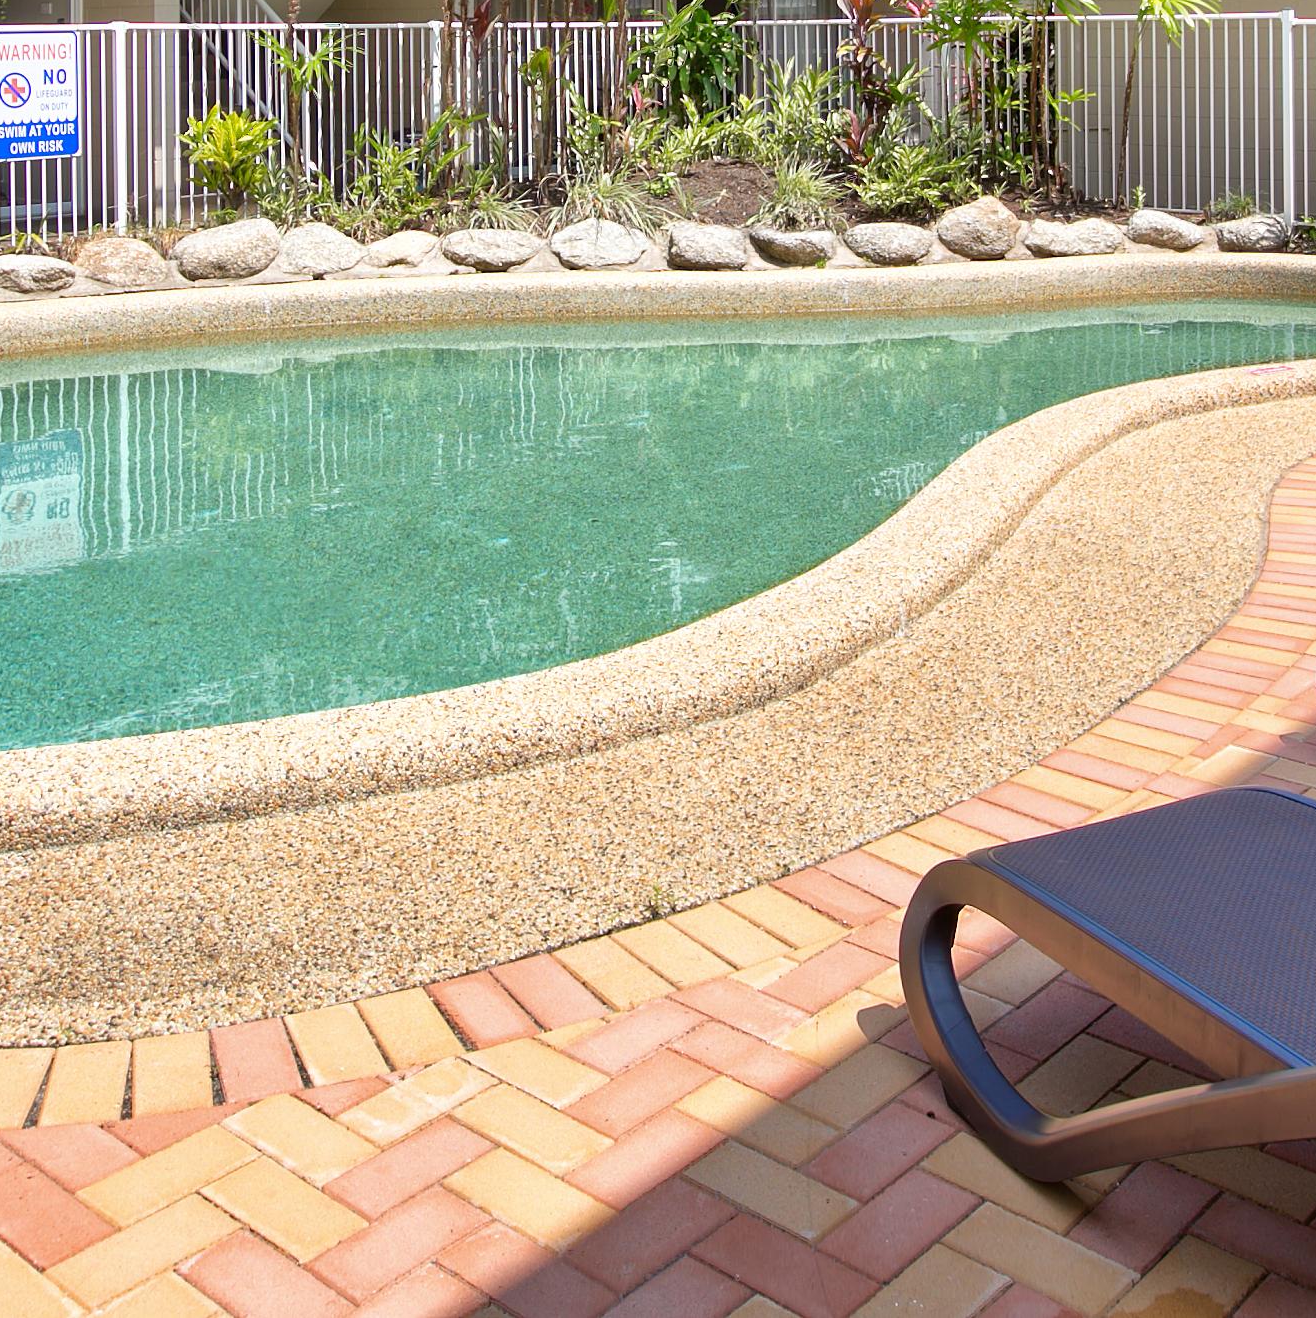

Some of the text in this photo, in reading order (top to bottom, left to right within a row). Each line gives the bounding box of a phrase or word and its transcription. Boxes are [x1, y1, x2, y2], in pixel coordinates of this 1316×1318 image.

[44, 68, 67, 85] NO
[36, 89, 73, 98] LIFEGUARD
[40, 102, 68, 111] ON DUTY
[29, 124, 43, 137] AT
[45, 123, 75, 136] YOUR
[10, 139, 64, 155] OWN RISK
